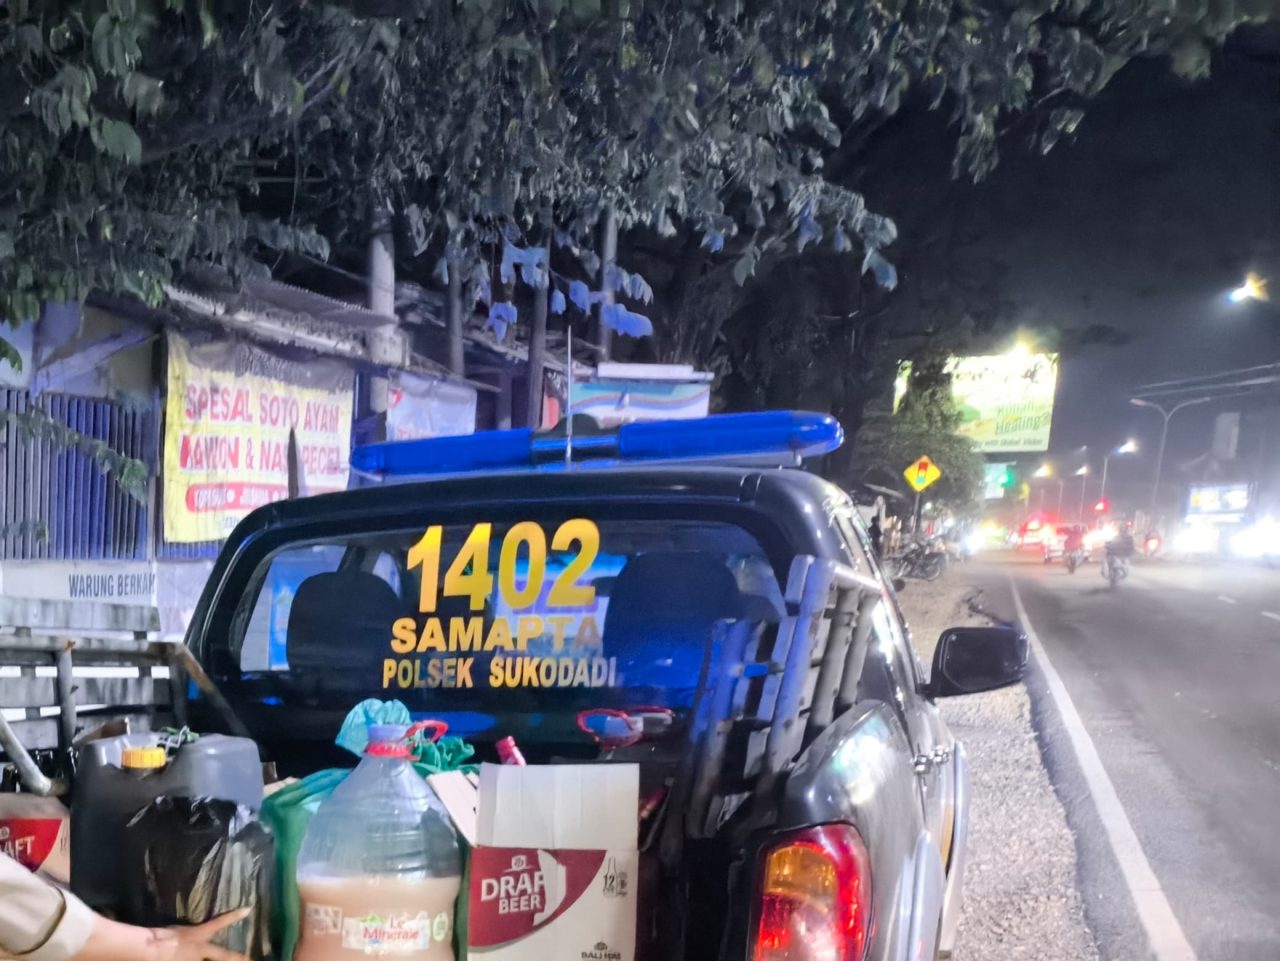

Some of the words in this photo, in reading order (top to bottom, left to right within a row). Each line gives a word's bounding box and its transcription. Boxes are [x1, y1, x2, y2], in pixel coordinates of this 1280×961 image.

[259, 393, 299, 428] SOTO
[303, 401, 339, 433] AYAM
[407, 519, 600, 613] 1402
[69, 573, 115, 598] WARUNG
[390, 616, 603, 653] SAMAPTA
[383, 657, 474, 689] POLSEK
[489, 656, 617, 688] SUKODADI
[499, 894, 542, 914] BEER
